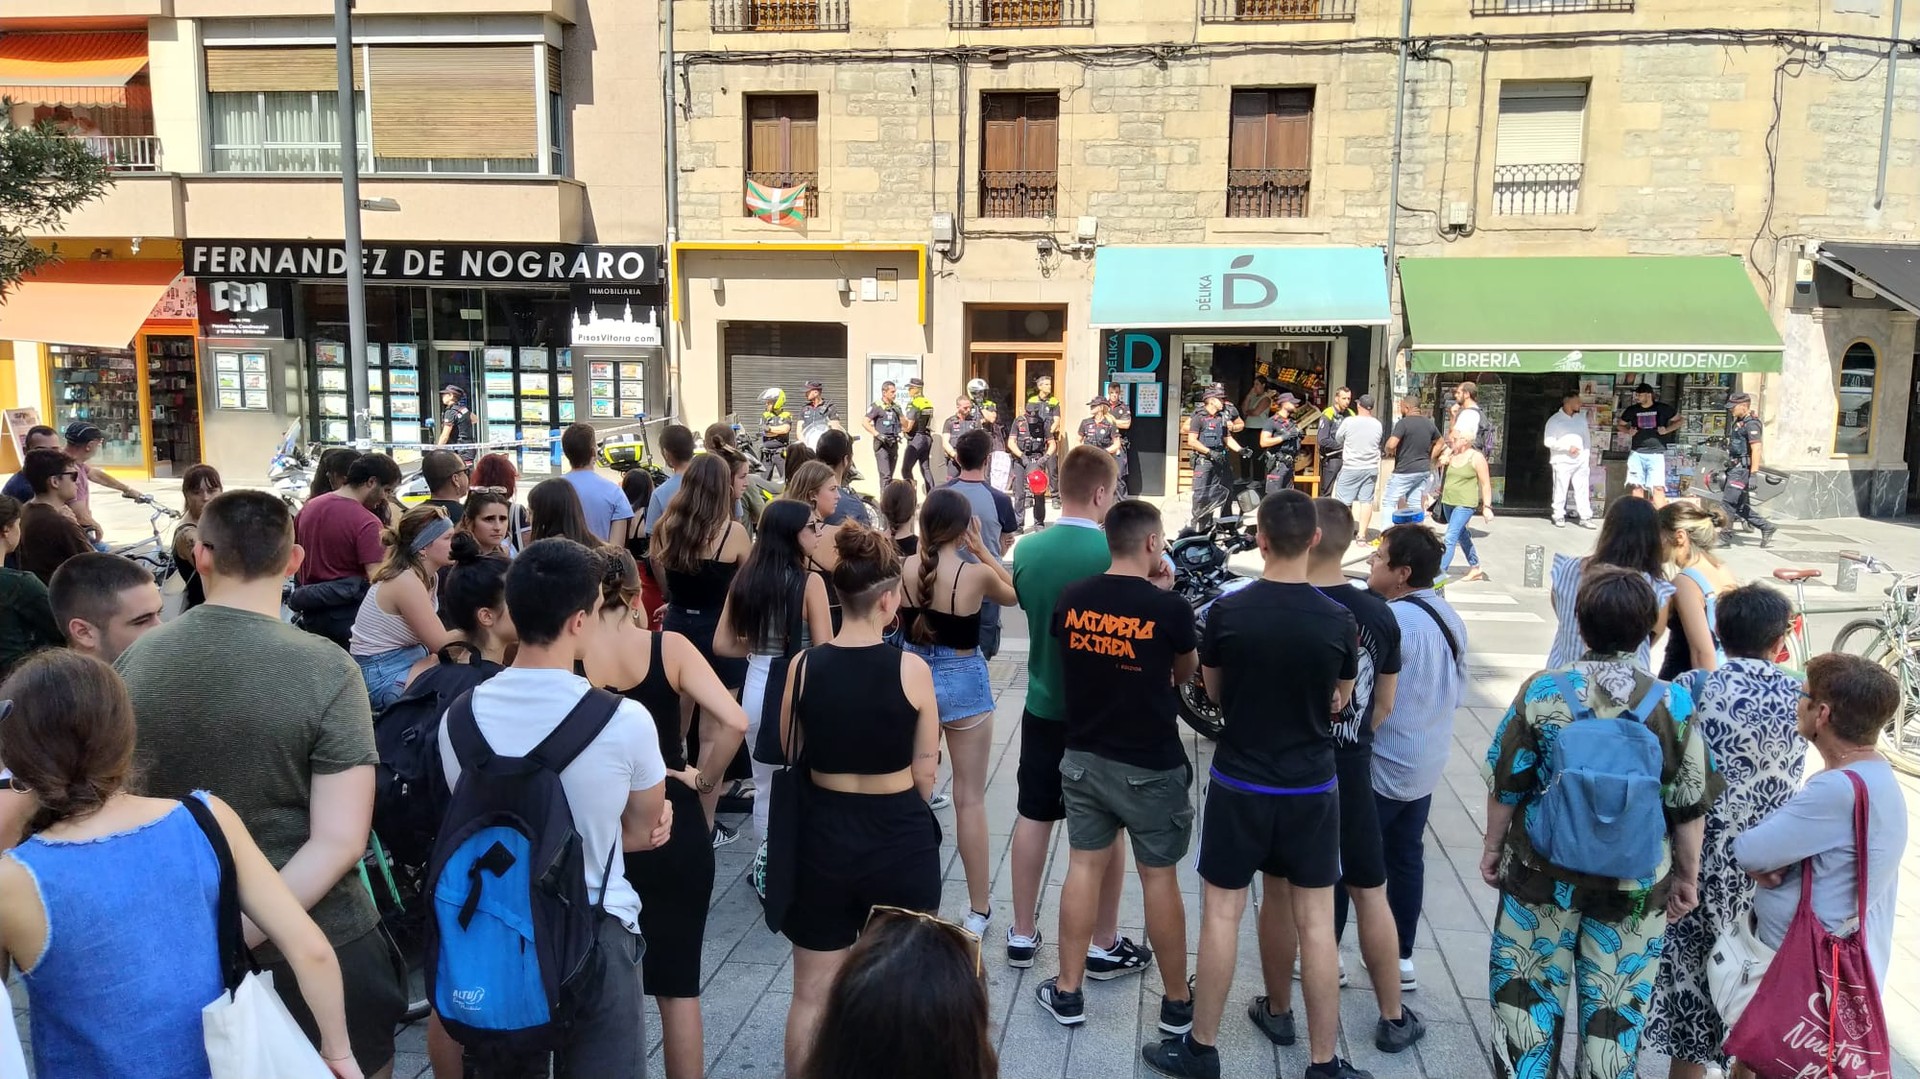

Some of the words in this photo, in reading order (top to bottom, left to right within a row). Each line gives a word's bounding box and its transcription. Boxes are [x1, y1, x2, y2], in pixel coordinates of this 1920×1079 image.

[403, 249, 445, 276] DE
[460, 251, 645, 279] NOGRARO
[1195, 274, 1212, 311] DÉLIKA
[1106, 334, 1118, 375] DÉLIKA
[1441, 352, 1521, 368] LIBRERIA
[1618, 352, 1750, 368] LIBURUDENDA
[1070, 631, 1136, 659] EXTREM
